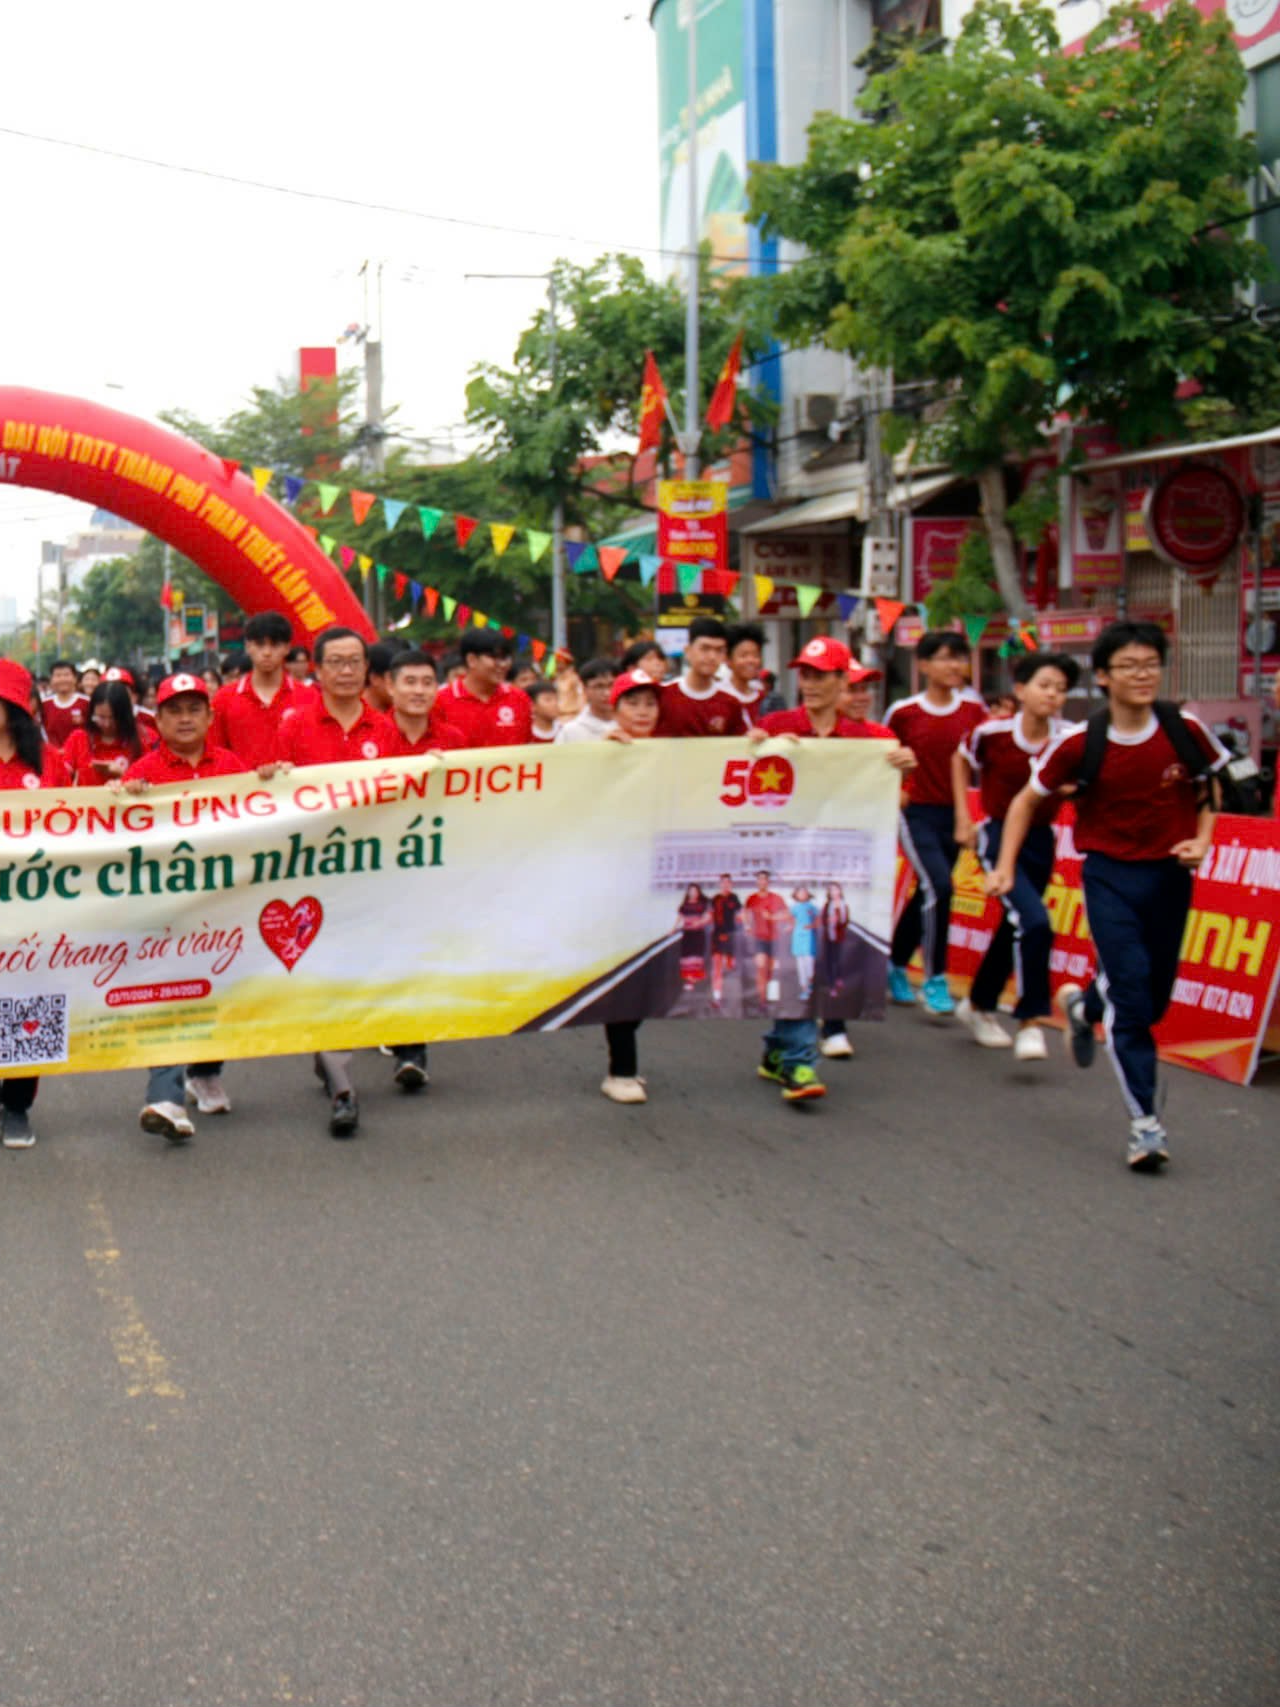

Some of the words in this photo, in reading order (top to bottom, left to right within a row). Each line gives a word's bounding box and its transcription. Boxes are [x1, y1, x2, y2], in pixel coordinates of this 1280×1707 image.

[197, 493, 248, 541] PHAN
[237, 525, 287, 574] THIẾT
[172, 790, 277, 827] ỨNG
[292, 769, 429, 813] CHIẾN
[444, 762, 543, 801] DỊCH
[96, 841, 234, 897] chân
[249, 826, 381, 884] nhân
[396, 814, 444, 868] ái
[48, 933, 128, 988] trang
[135, 926, 170, 960] sử
[176, 922, 245, 975] vàng
[1179, 908, 1271, 977] INH
